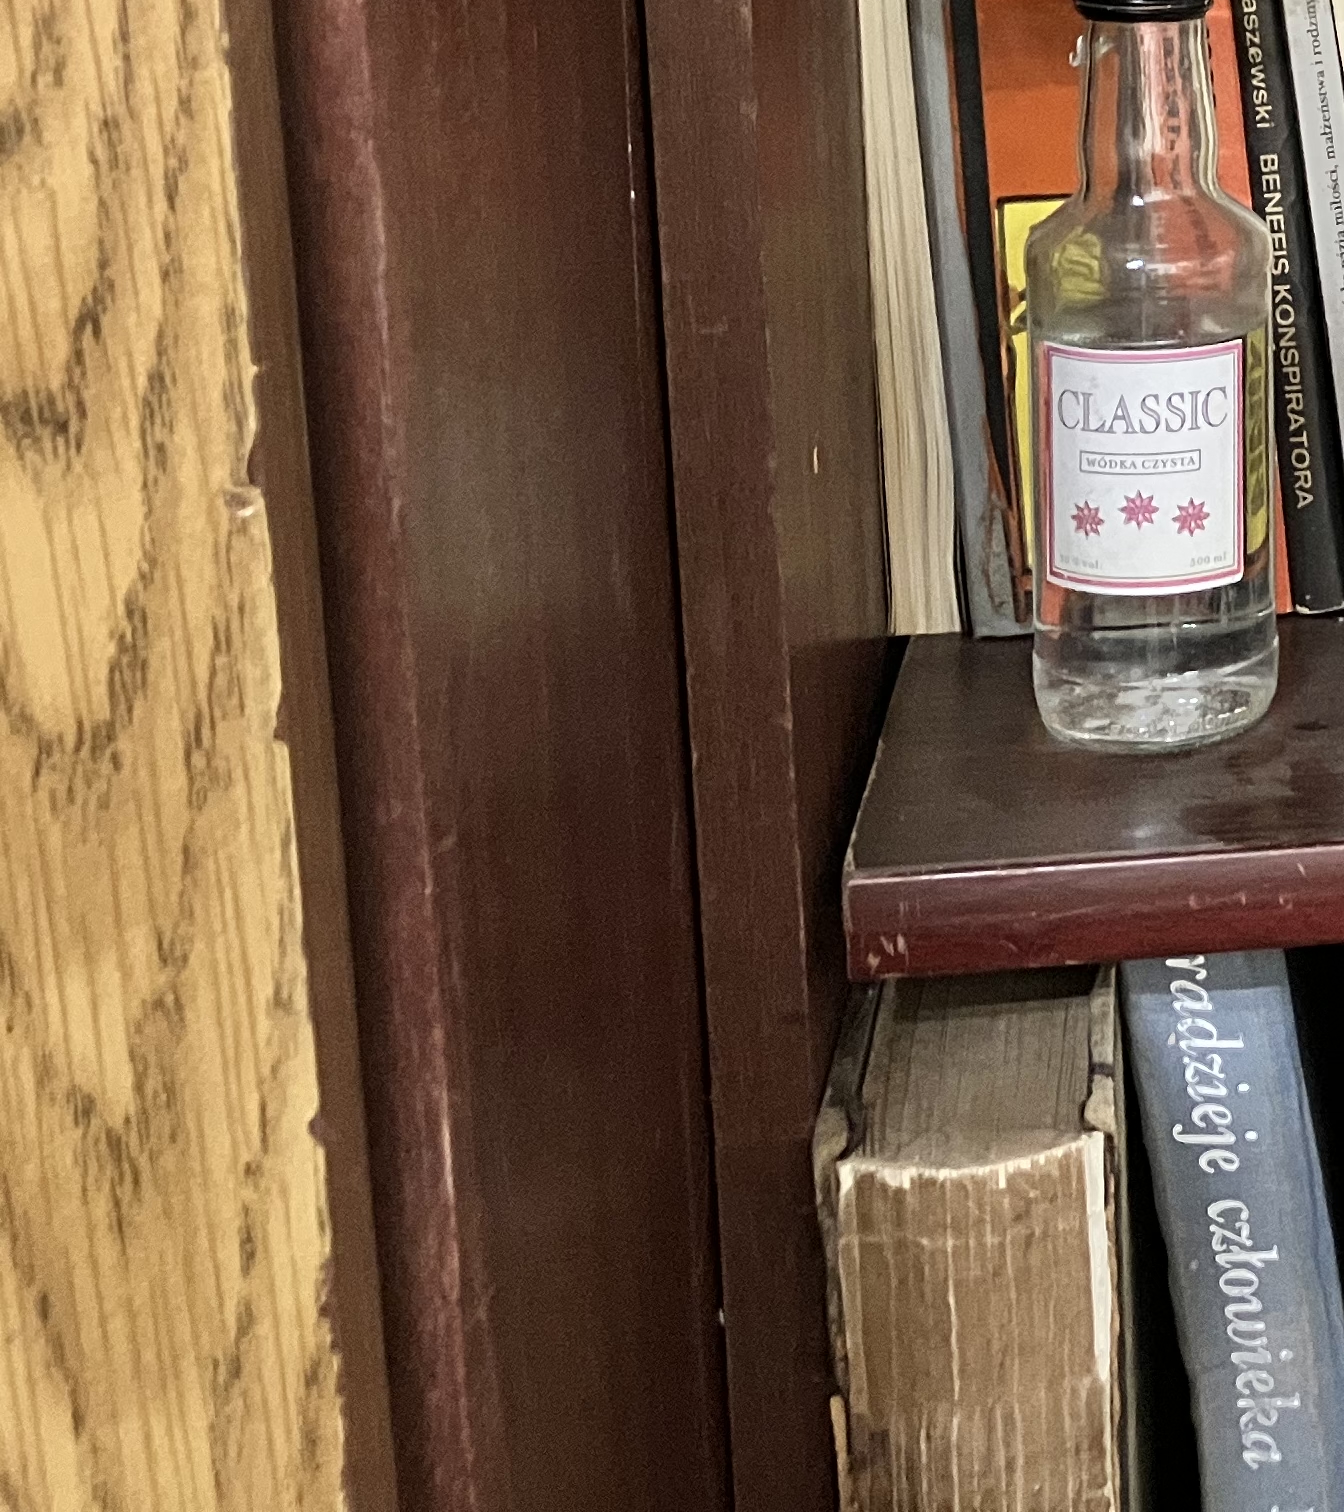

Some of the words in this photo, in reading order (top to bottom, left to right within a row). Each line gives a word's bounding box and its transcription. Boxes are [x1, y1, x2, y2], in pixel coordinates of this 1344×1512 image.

[1316, 68, 1336, 160] małżeństwa
[1258, 153, 1290, 276] BENEFIS
[1056, 386, 1229, 435] CLASSIC
[1272, 282, 1315, 510] KONSPIRATORA
[1085, 454, 1138, 472] WÓDKA
[1140, 454, 1197, 471] CZYSTA
[1165, 954, 1259, 1175] radzieje
[1206, 1198, 1302, 1471] człowieka
